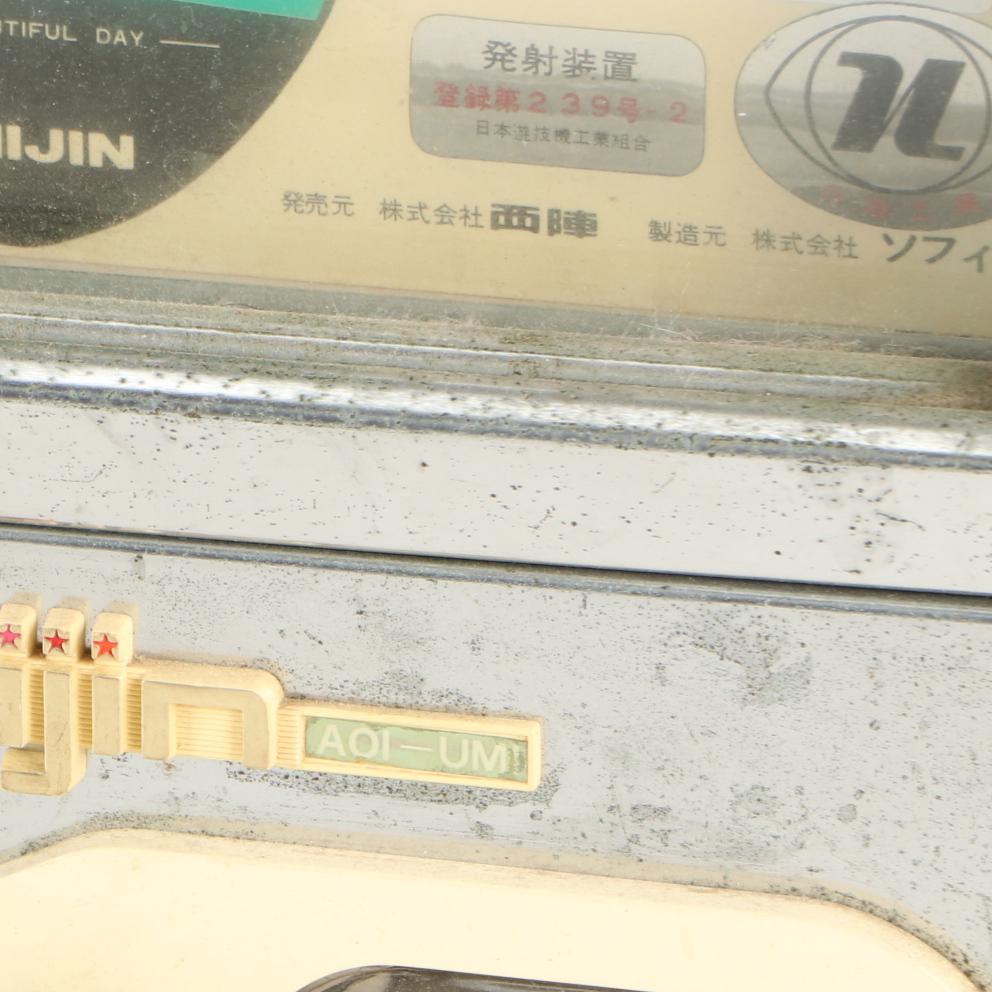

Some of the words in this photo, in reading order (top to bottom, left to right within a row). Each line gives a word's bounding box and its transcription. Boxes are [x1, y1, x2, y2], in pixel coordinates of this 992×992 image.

[95, 27, 145, 47] DAY
[481, 39, 639, 83] 発射装置
[281, 190, 356, 218] 発売元
[647, 218, 728, 248] 製造元
[751, 227, 860, 260] 株式会社
